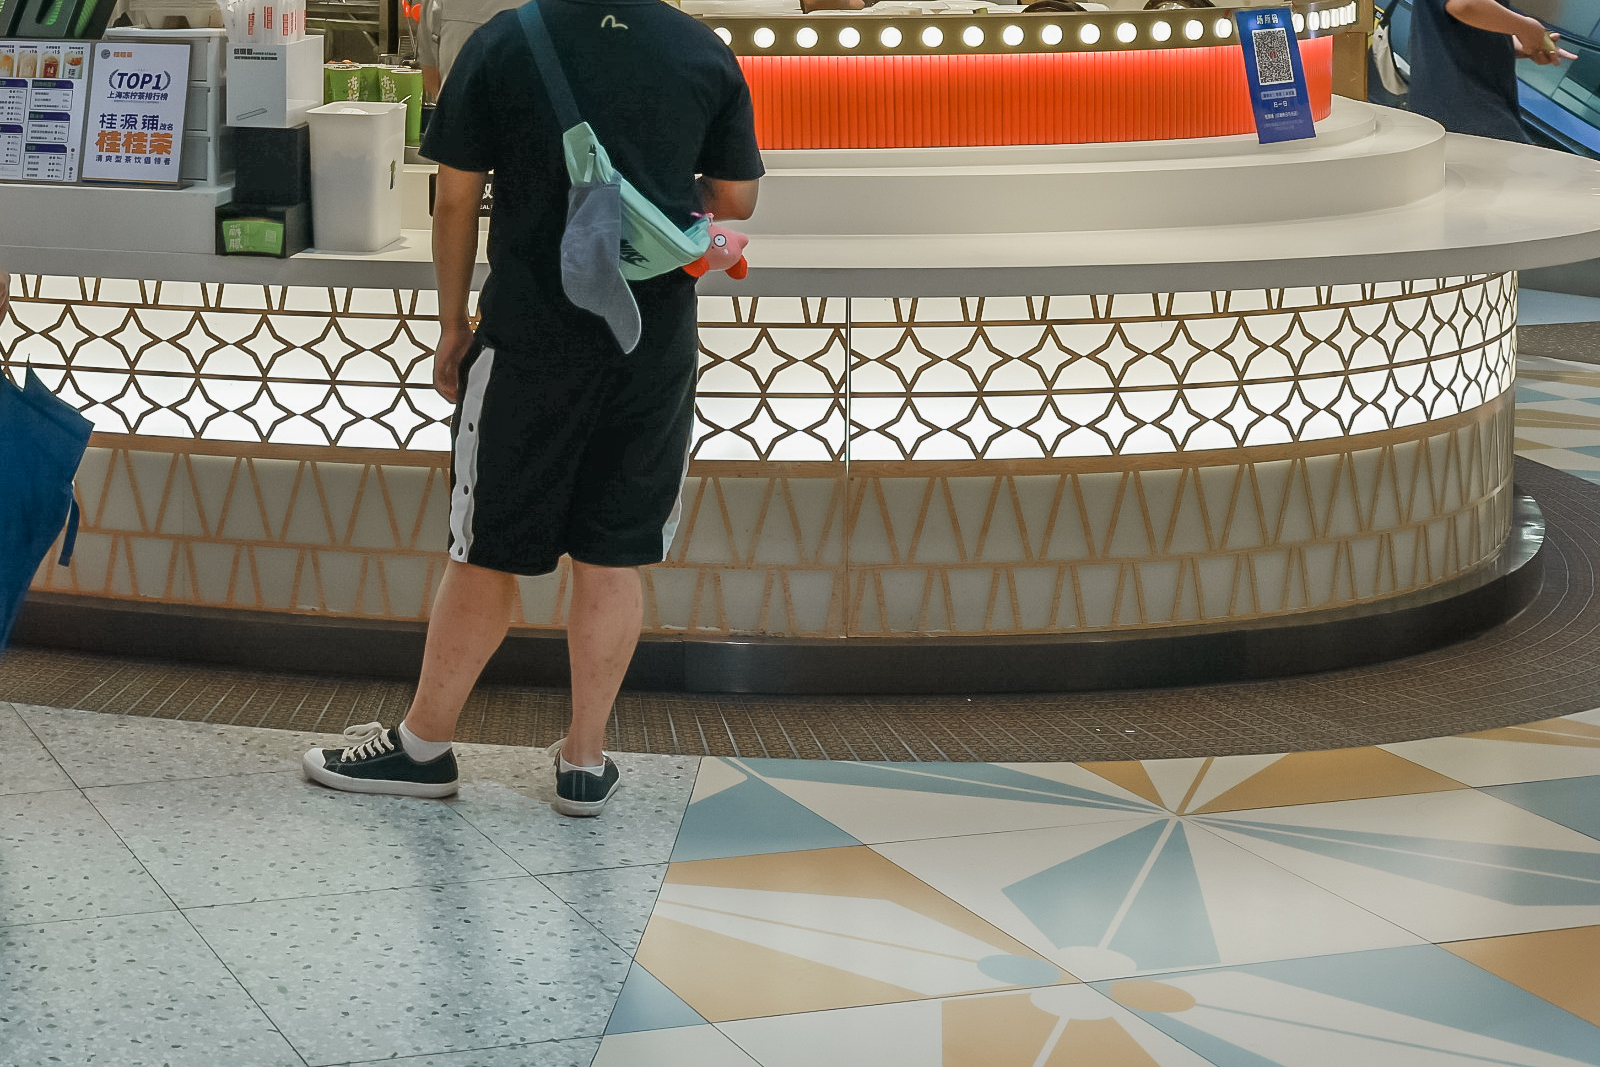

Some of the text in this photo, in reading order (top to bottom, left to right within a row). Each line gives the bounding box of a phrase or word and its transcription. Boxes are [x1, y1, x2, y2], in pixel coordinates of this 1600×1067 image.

[1257, 14, 1279, 25] 场所码
[117, 73, 163, 90] TOP1
[107, 91, 168, 101] 上海冻柠茶排行榜
[160, 122, 174, 131] 改名
[95, 130, 173, 155] 桂桂茶
